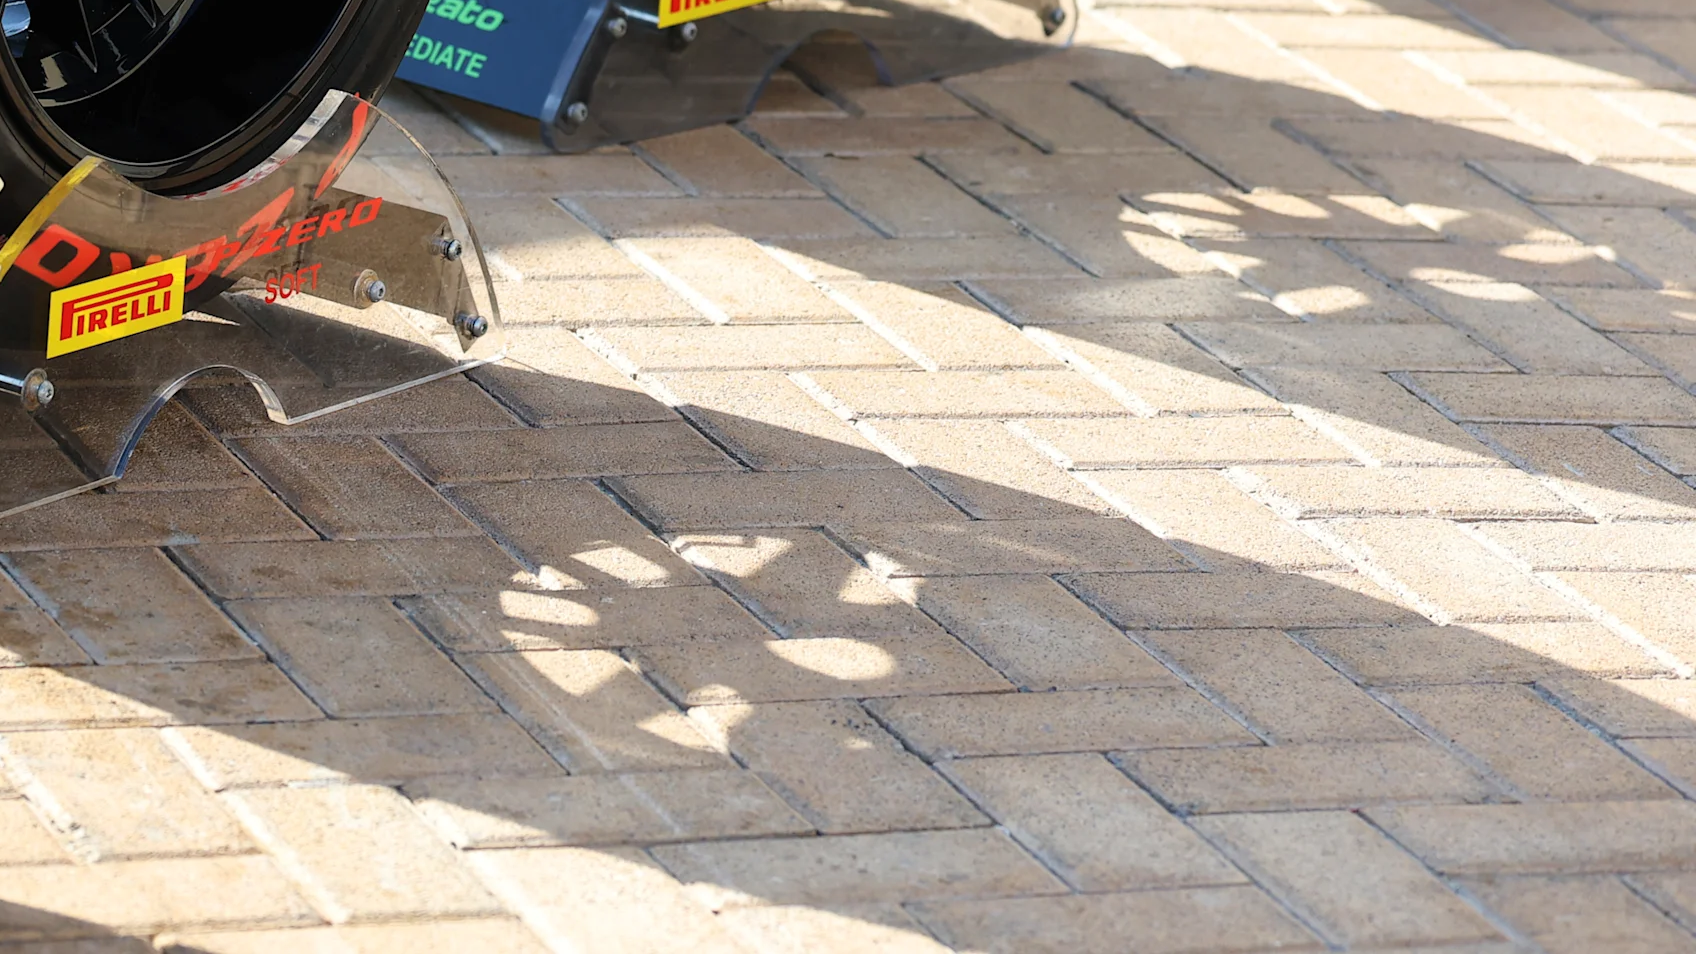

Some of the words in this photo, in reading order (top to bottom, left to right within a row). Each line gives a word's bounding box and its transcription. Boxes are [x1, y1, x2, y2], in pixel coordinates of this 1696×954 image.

[252, 197, 383, 258] ZERO
[60, 273, 174, 341] PIRELLI
[265, 264, 322, 304] SOFT
